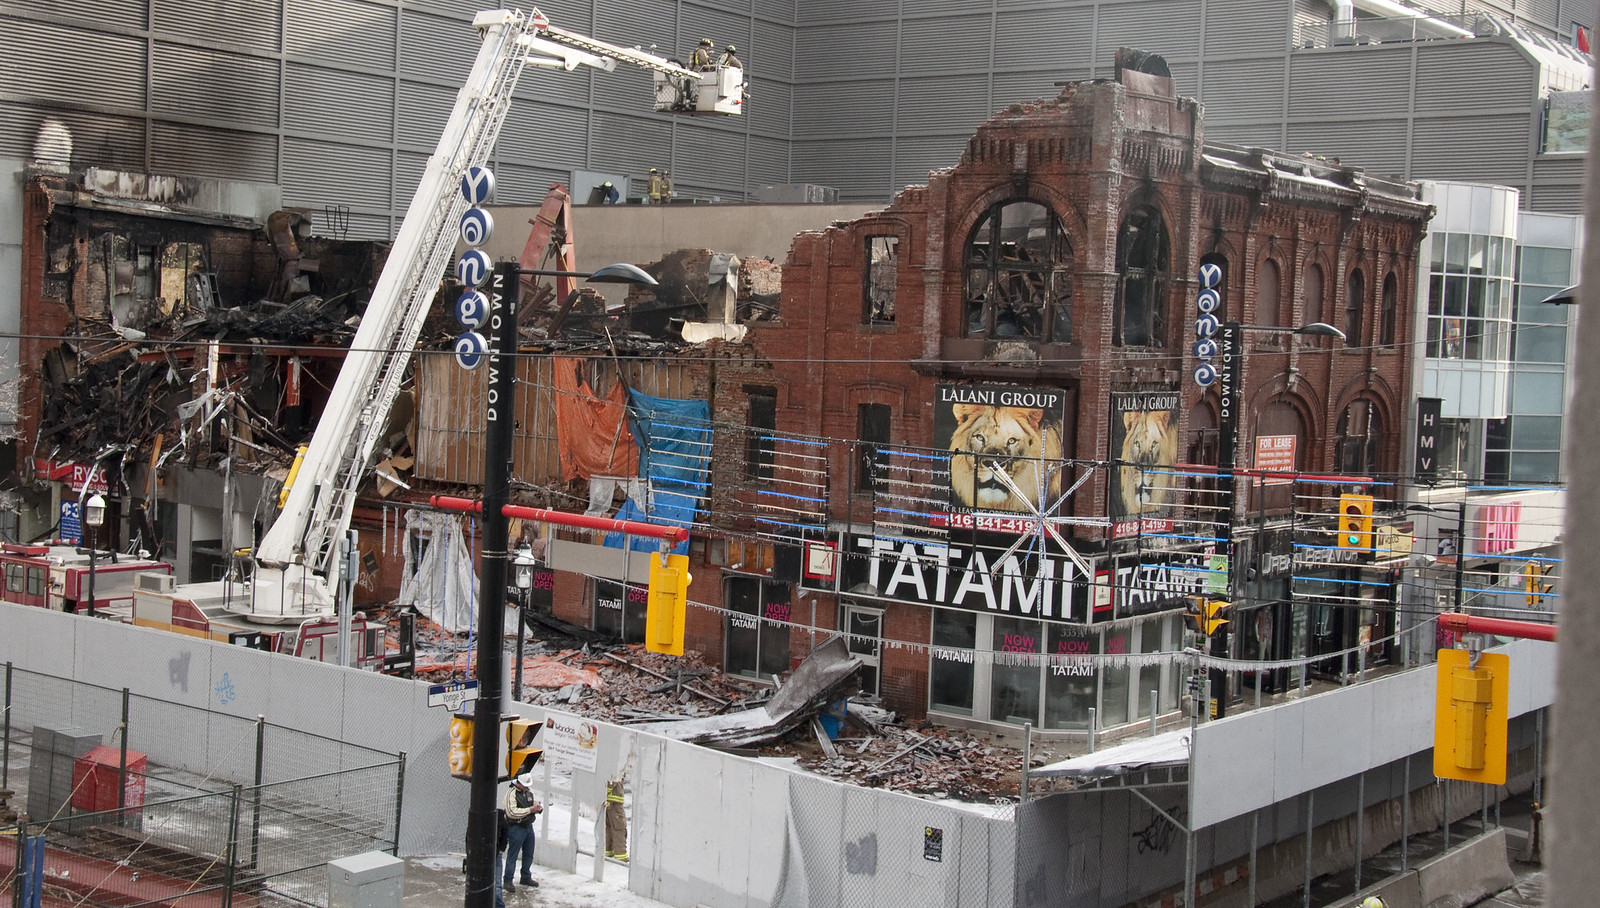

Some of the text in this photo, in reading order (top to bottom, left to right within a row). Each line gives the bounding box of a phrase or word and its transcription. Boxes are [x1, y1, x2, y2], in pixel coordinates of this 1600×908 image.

[487, 274, 504, 421] DOWNTOWN
[1221, 328, 1233, 418] DOWNTOWN
[942, 388, 1057, 408] LALANI GROUP
[1149, 396, 1178, 410] GROUP
[1260, 438, 1292, 449] FOR LEASE
[1420, 413, 1434, 470] HMV
[945, 513, 1044, 531] 416-841-419
[1482, 501, 1522, 554] HMV
[534, 571, 554, 581] NOW
[858, 537, 1074, 620] TATAMI
[1118, 558, 1198, 607] TATAMI
[598, 599, 622, 610] TATAMI
[628, 592, 649, 604] OPE
[767, 602, 790, 615] NOW
[731, 618, 757, 630] TATAMI
[765, 612, 790, 623] OPEN
[1004, 633, 1034, 648] NOW
[1058, 641, 1089, 652] NOW
[1109, 636, 1125, 649] NOW
[937, 648, 974, 664] TATAMI
[1051, 665, 1093, 677] TATAMI
[443, 691, 466, 703] Yonge St
